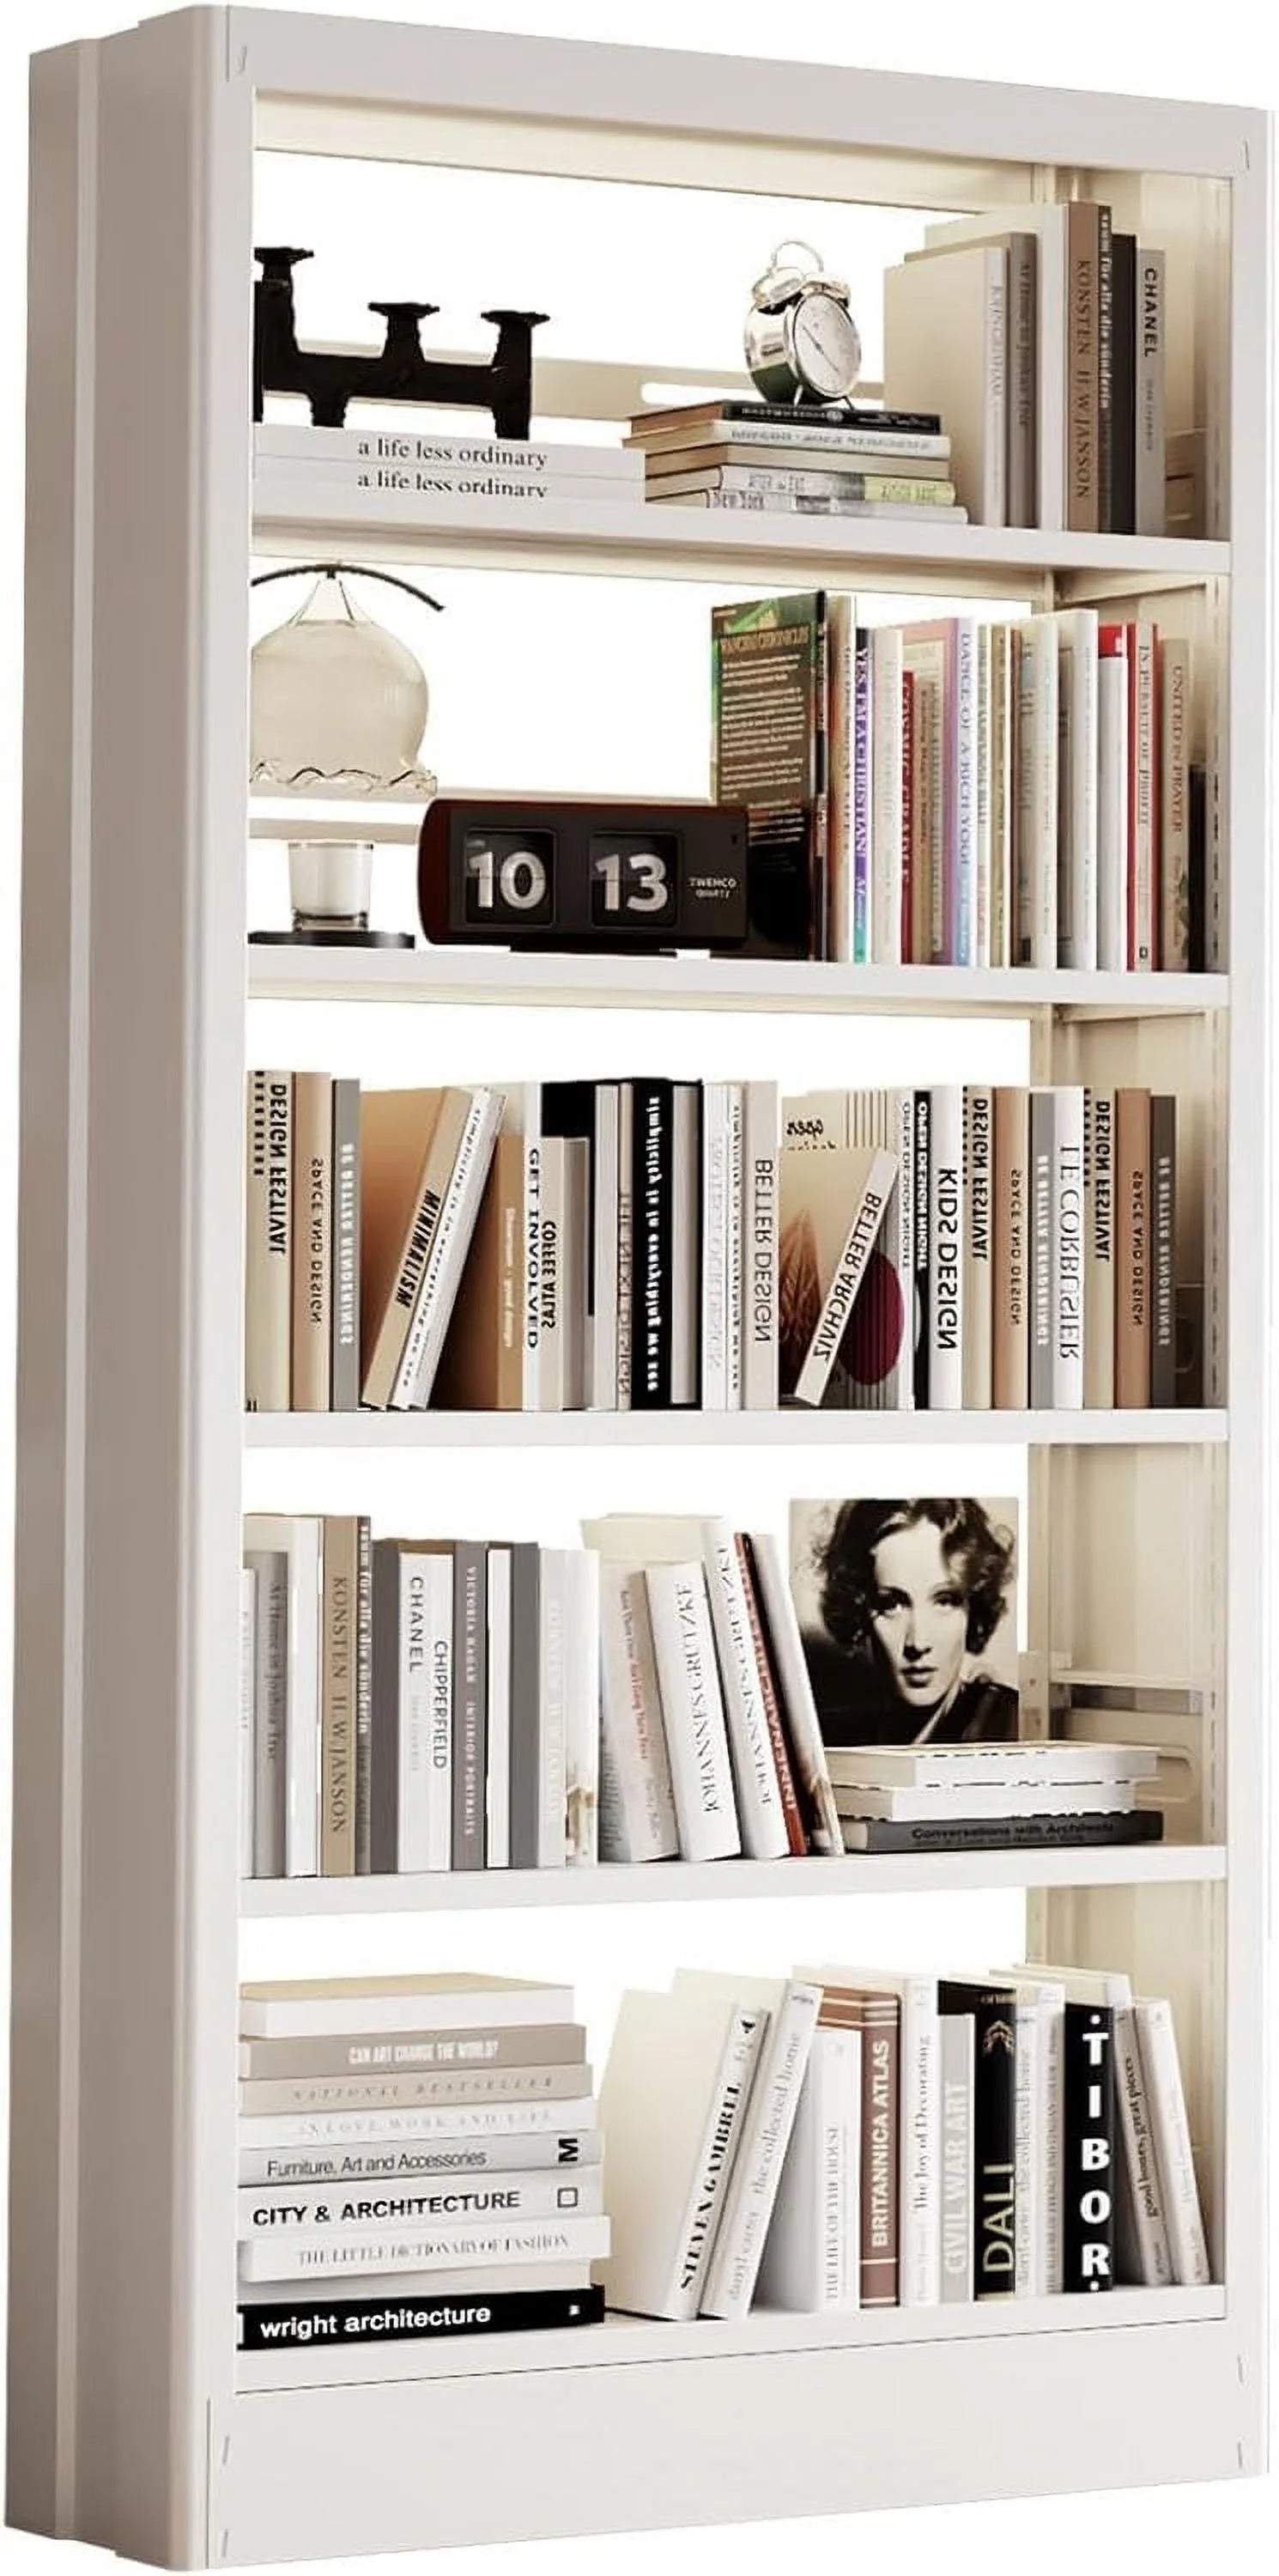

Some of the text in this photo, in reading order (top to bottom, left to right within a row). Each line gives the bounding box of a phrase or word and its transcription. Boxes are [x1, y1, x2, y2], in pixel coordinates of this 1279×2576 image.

[1076, 259, 1092, 355] KONSTEN
[1144, 267, 1159, 358] CHANEL
[358, 438, 548, 470] a life less ordinary
[358, 473, 369, 488] a
[378, 470, 409, 491] life
[415, 472, 453, 493] less
[468, 850, 546, 910] 10
[594, 853, 669, 913] 13
[397, 1189, 441, 1309] MINIMALISM
[527, 1147, 540, 1351] GET INVOLVED
[330, 1577, 348, 1679] KONSTEN
[408, 1576, 425, 1674] CHANEL
[433, 1640, 449, 1769] CHIPPERFIELD
[870, 2040, 889, 2246] BRITANNICA ATLAS
[945, 2079, 967, 2130] ART
[341, 2157, 363, 2172] Art
[365, 2154, 396, 2172] and
[397, 2151, 488, 2170] Accessories
[945, 2139, 967, 2201] WAR
[1079, 2031, 1112, 2277] TIBOR
[252, 2190, 522, 2227] CITY & ARCHITECTURE
[982, 2163, 1015, 2272] DALI
[259, 2305, 492, 2341] wright architecture
